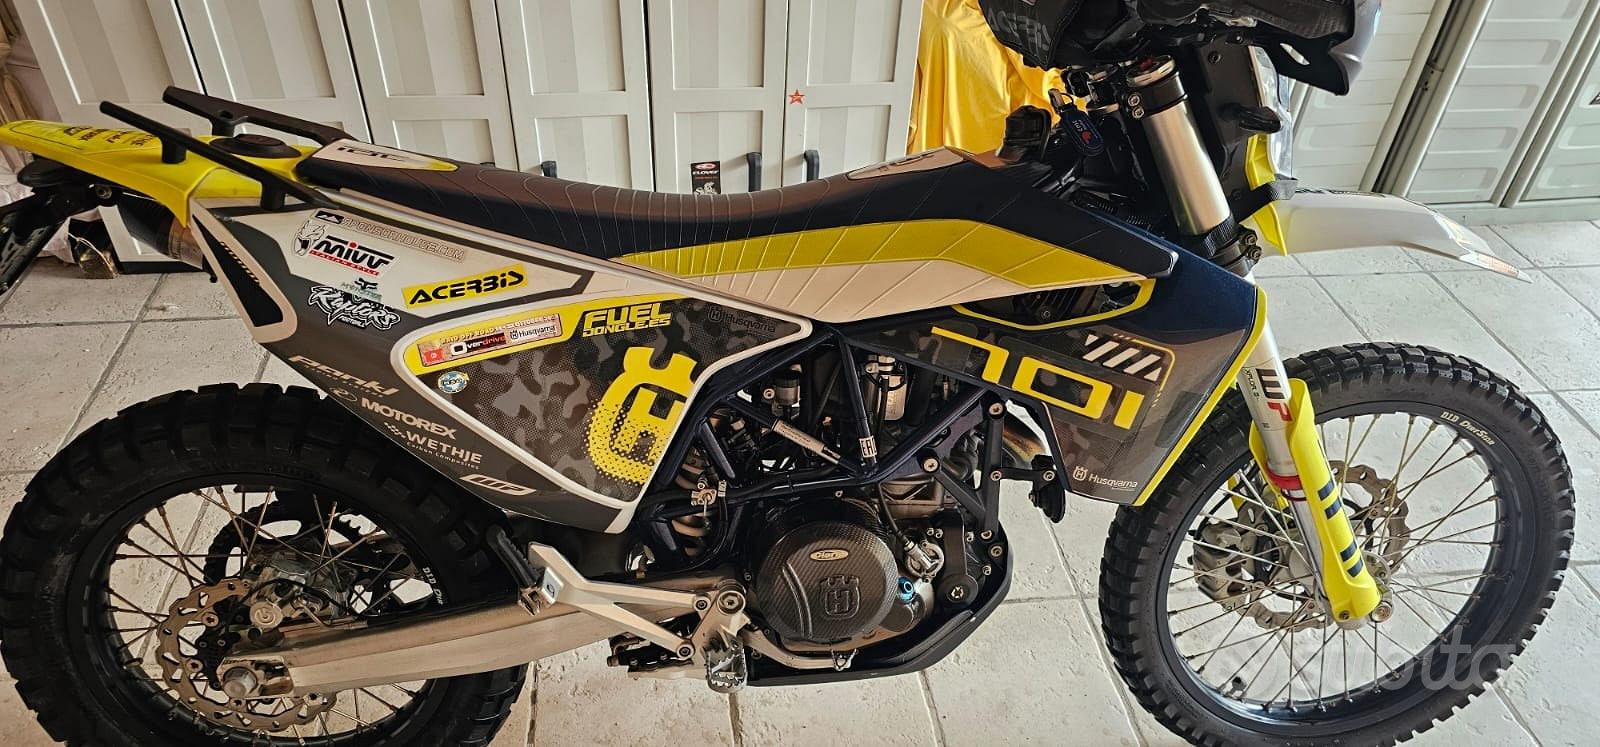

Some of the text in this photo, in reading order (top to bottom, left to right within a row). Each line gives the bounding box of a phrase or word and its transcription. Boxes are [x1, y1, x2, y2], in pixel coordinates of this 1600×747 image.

[317, 235, 395, 269] MIVV
[408, 270, 526, 305] ACERBIS
[583, 303, 672, 329] FUEL
[723, 312, 777, 333] Husqvarna
[518, 325, 556, 338] Husqvarna
[930, 326, 1145, 430] 701
[361, 397, 458, 439] MOTOREX
[1440, 410, 1460, 423] DID
[406, 430, 484, 464] WETHJE
[1088, 473, 1138, 488] Husqvarna
